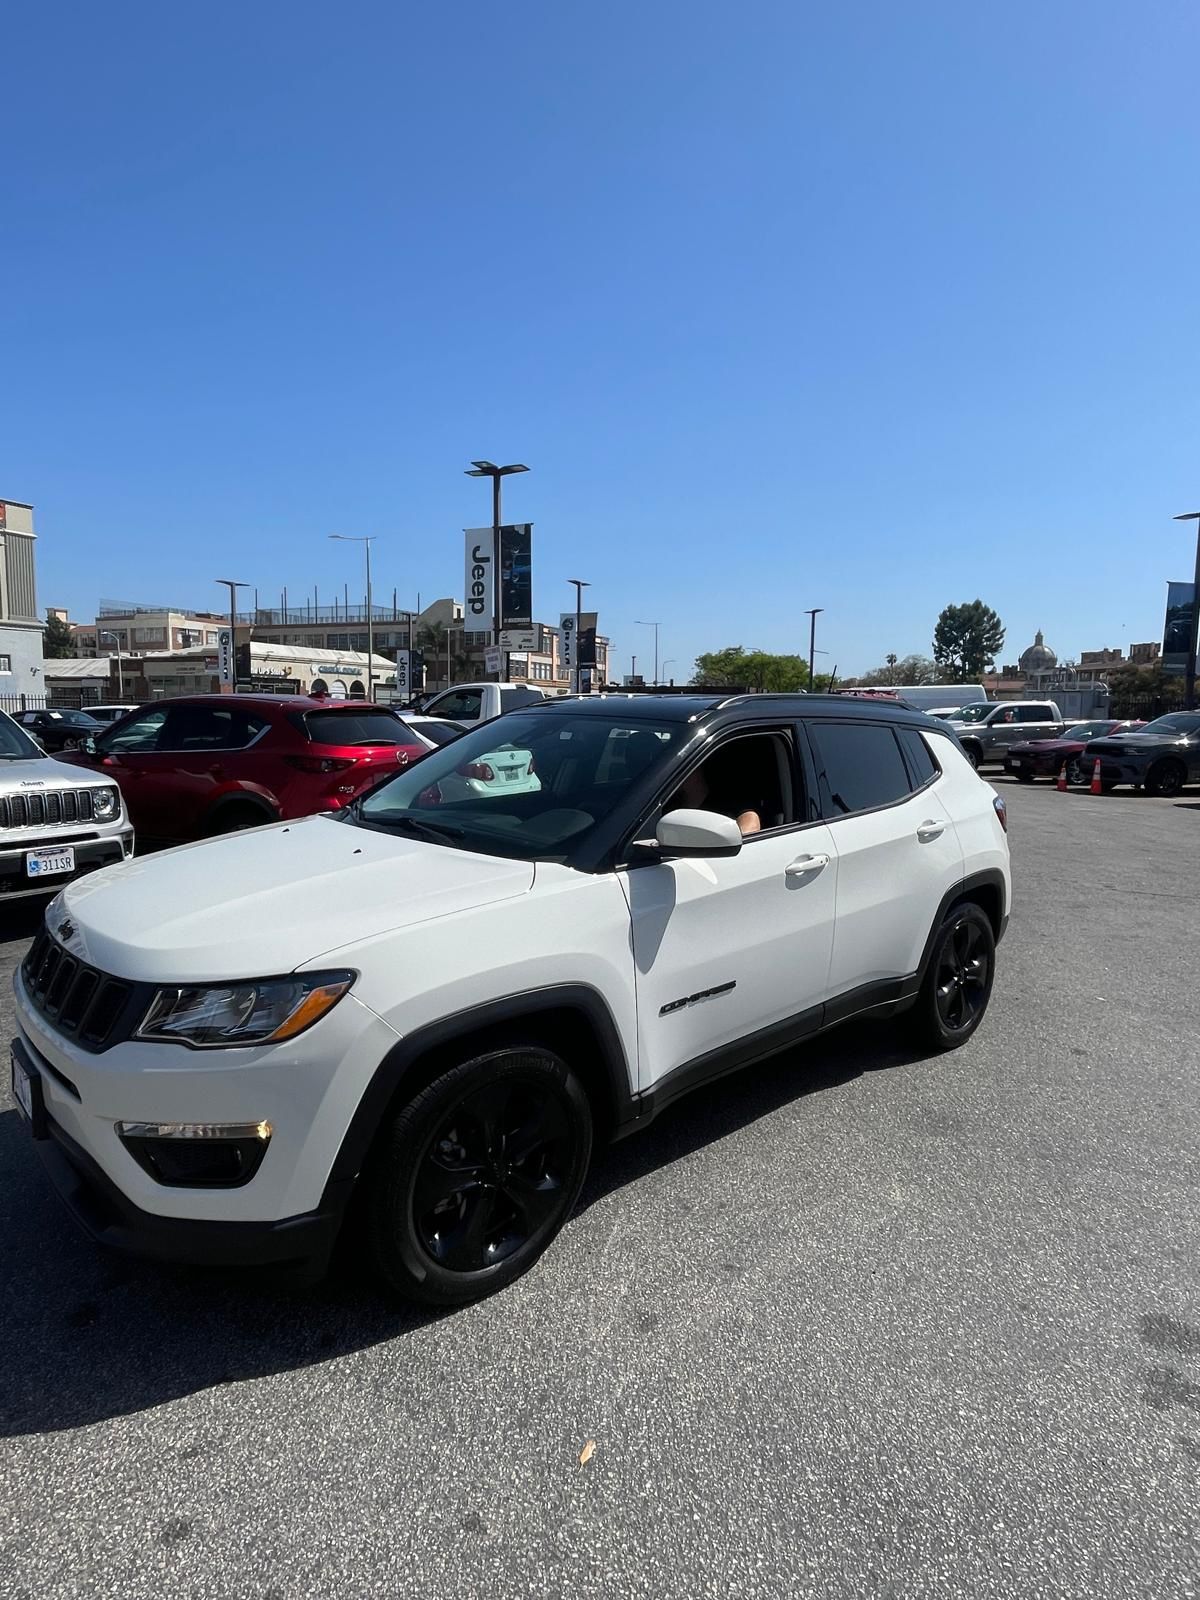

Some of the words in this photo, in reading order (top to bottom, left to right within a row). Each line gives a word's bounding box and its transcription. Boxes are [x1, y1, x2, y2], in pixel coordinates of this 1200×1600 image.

[467, 545, 491, 615] Jeep
[399, 657, 408, 687] Jeep
[42, 856, 72, 872] 311SR
